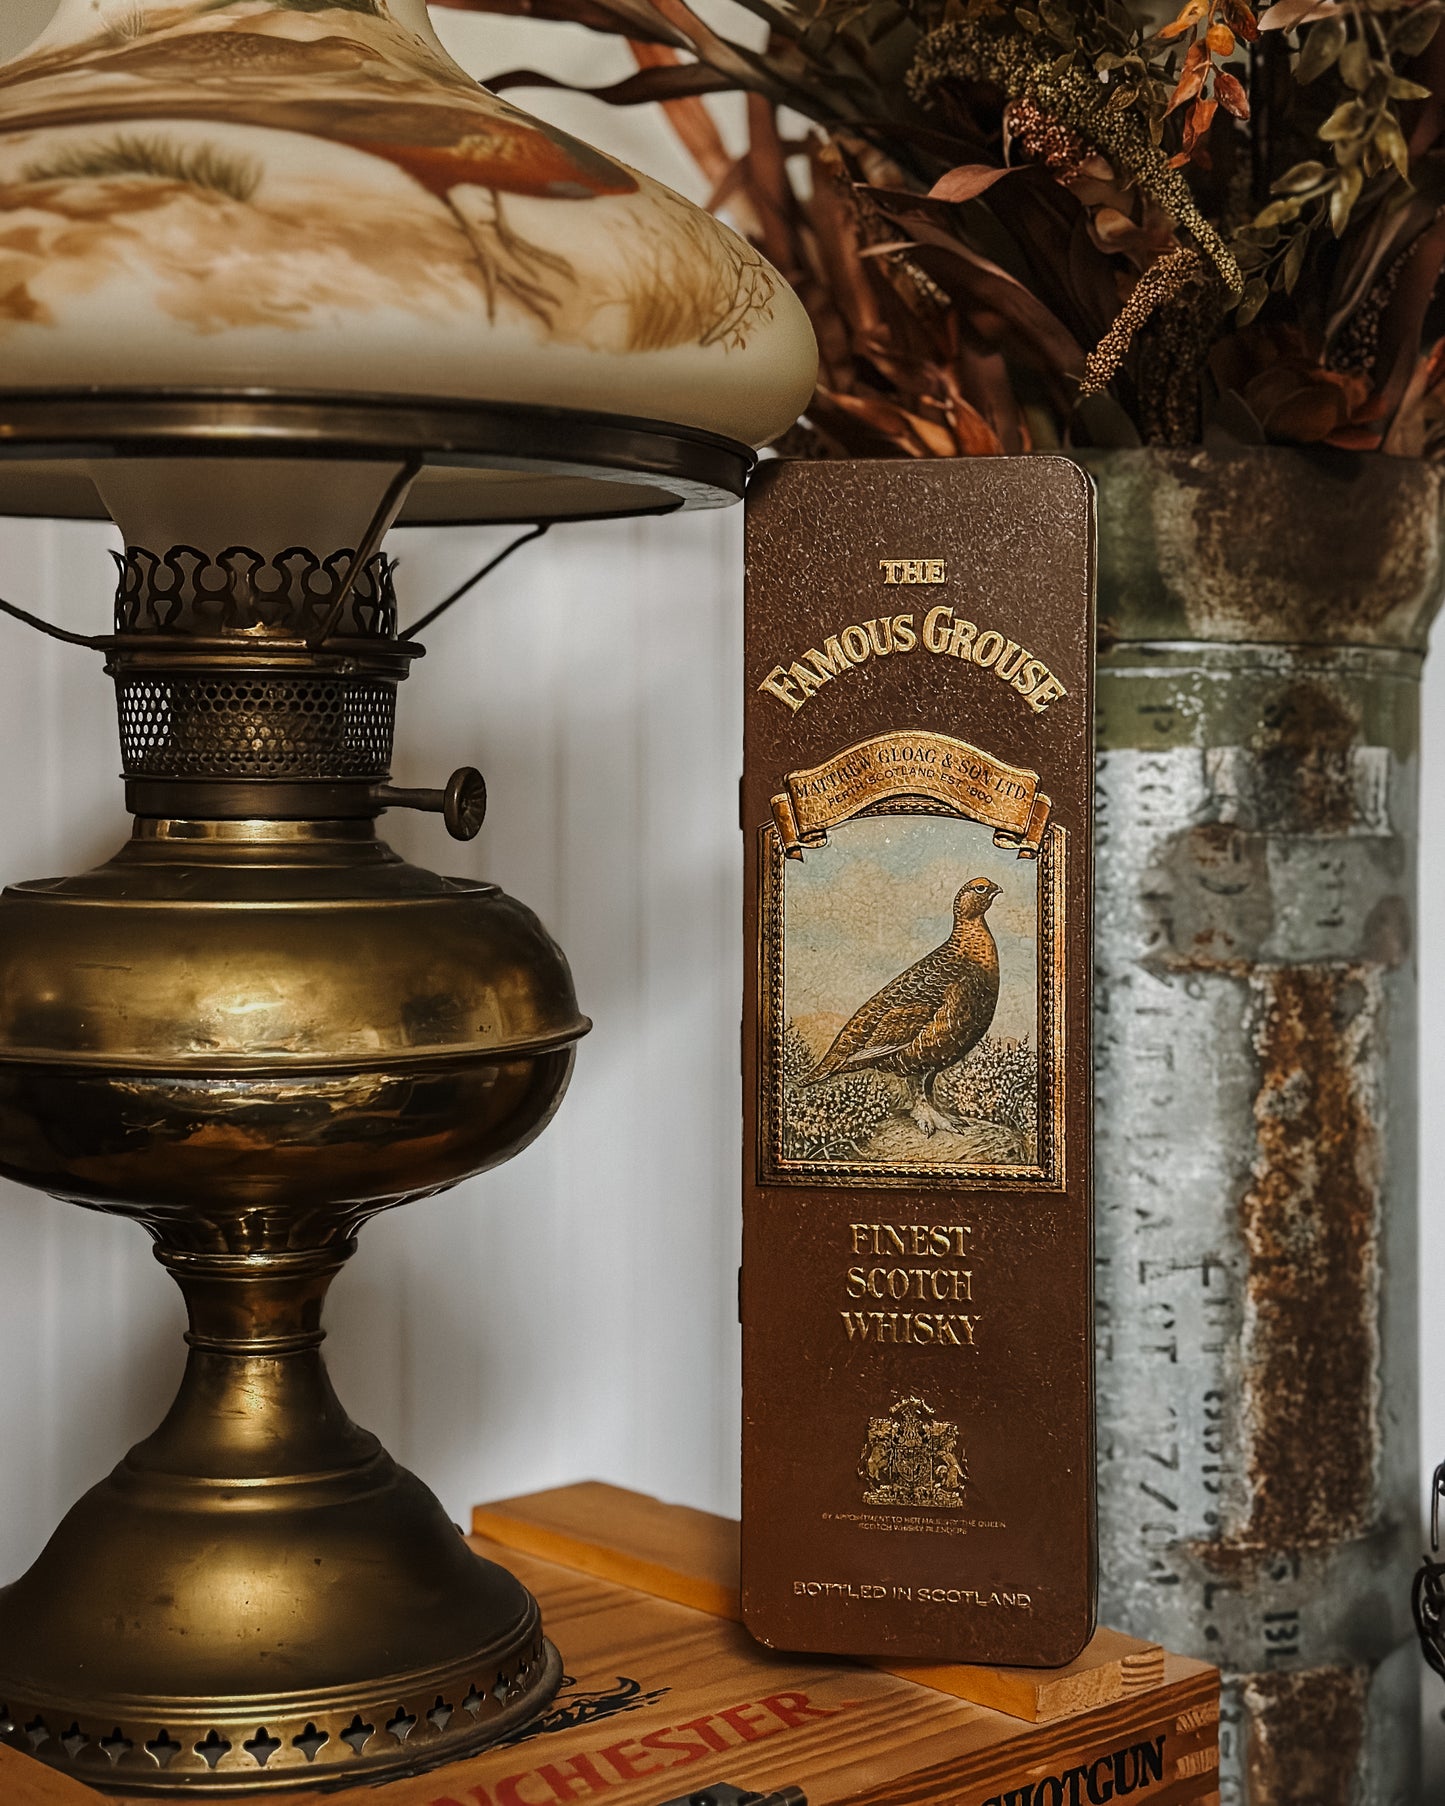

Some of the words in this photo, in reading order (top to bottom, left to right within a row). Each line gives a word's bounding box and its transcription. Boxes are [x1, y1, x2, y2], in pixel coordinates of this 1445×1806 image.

[880, 559, 948, 585] THE
[757, 614, 917, 715] FAMOUS
[922, 605, 1067, 714] GROUSE
[794, 755, 873, 799] MATTHEW
[878, 746, 937, 765] GLOAG
[942, 753, 953, 769] &
[959, 760, 994, 786] SON
[994, 778, 1028, 801] LTD
[828, 782, 865, 807] PERTH
[848, 1223, 975, 1258] FINEST
[846, 1266, 974, 1301] SCOTCH
[840, 1311, 982, 1345] WHISKY
[793, 1580, 887, 1600] BOTTLED
[893, 1585, 912, 1601] IN
[917, 1587, 1032, 1610] SCOTLAND
